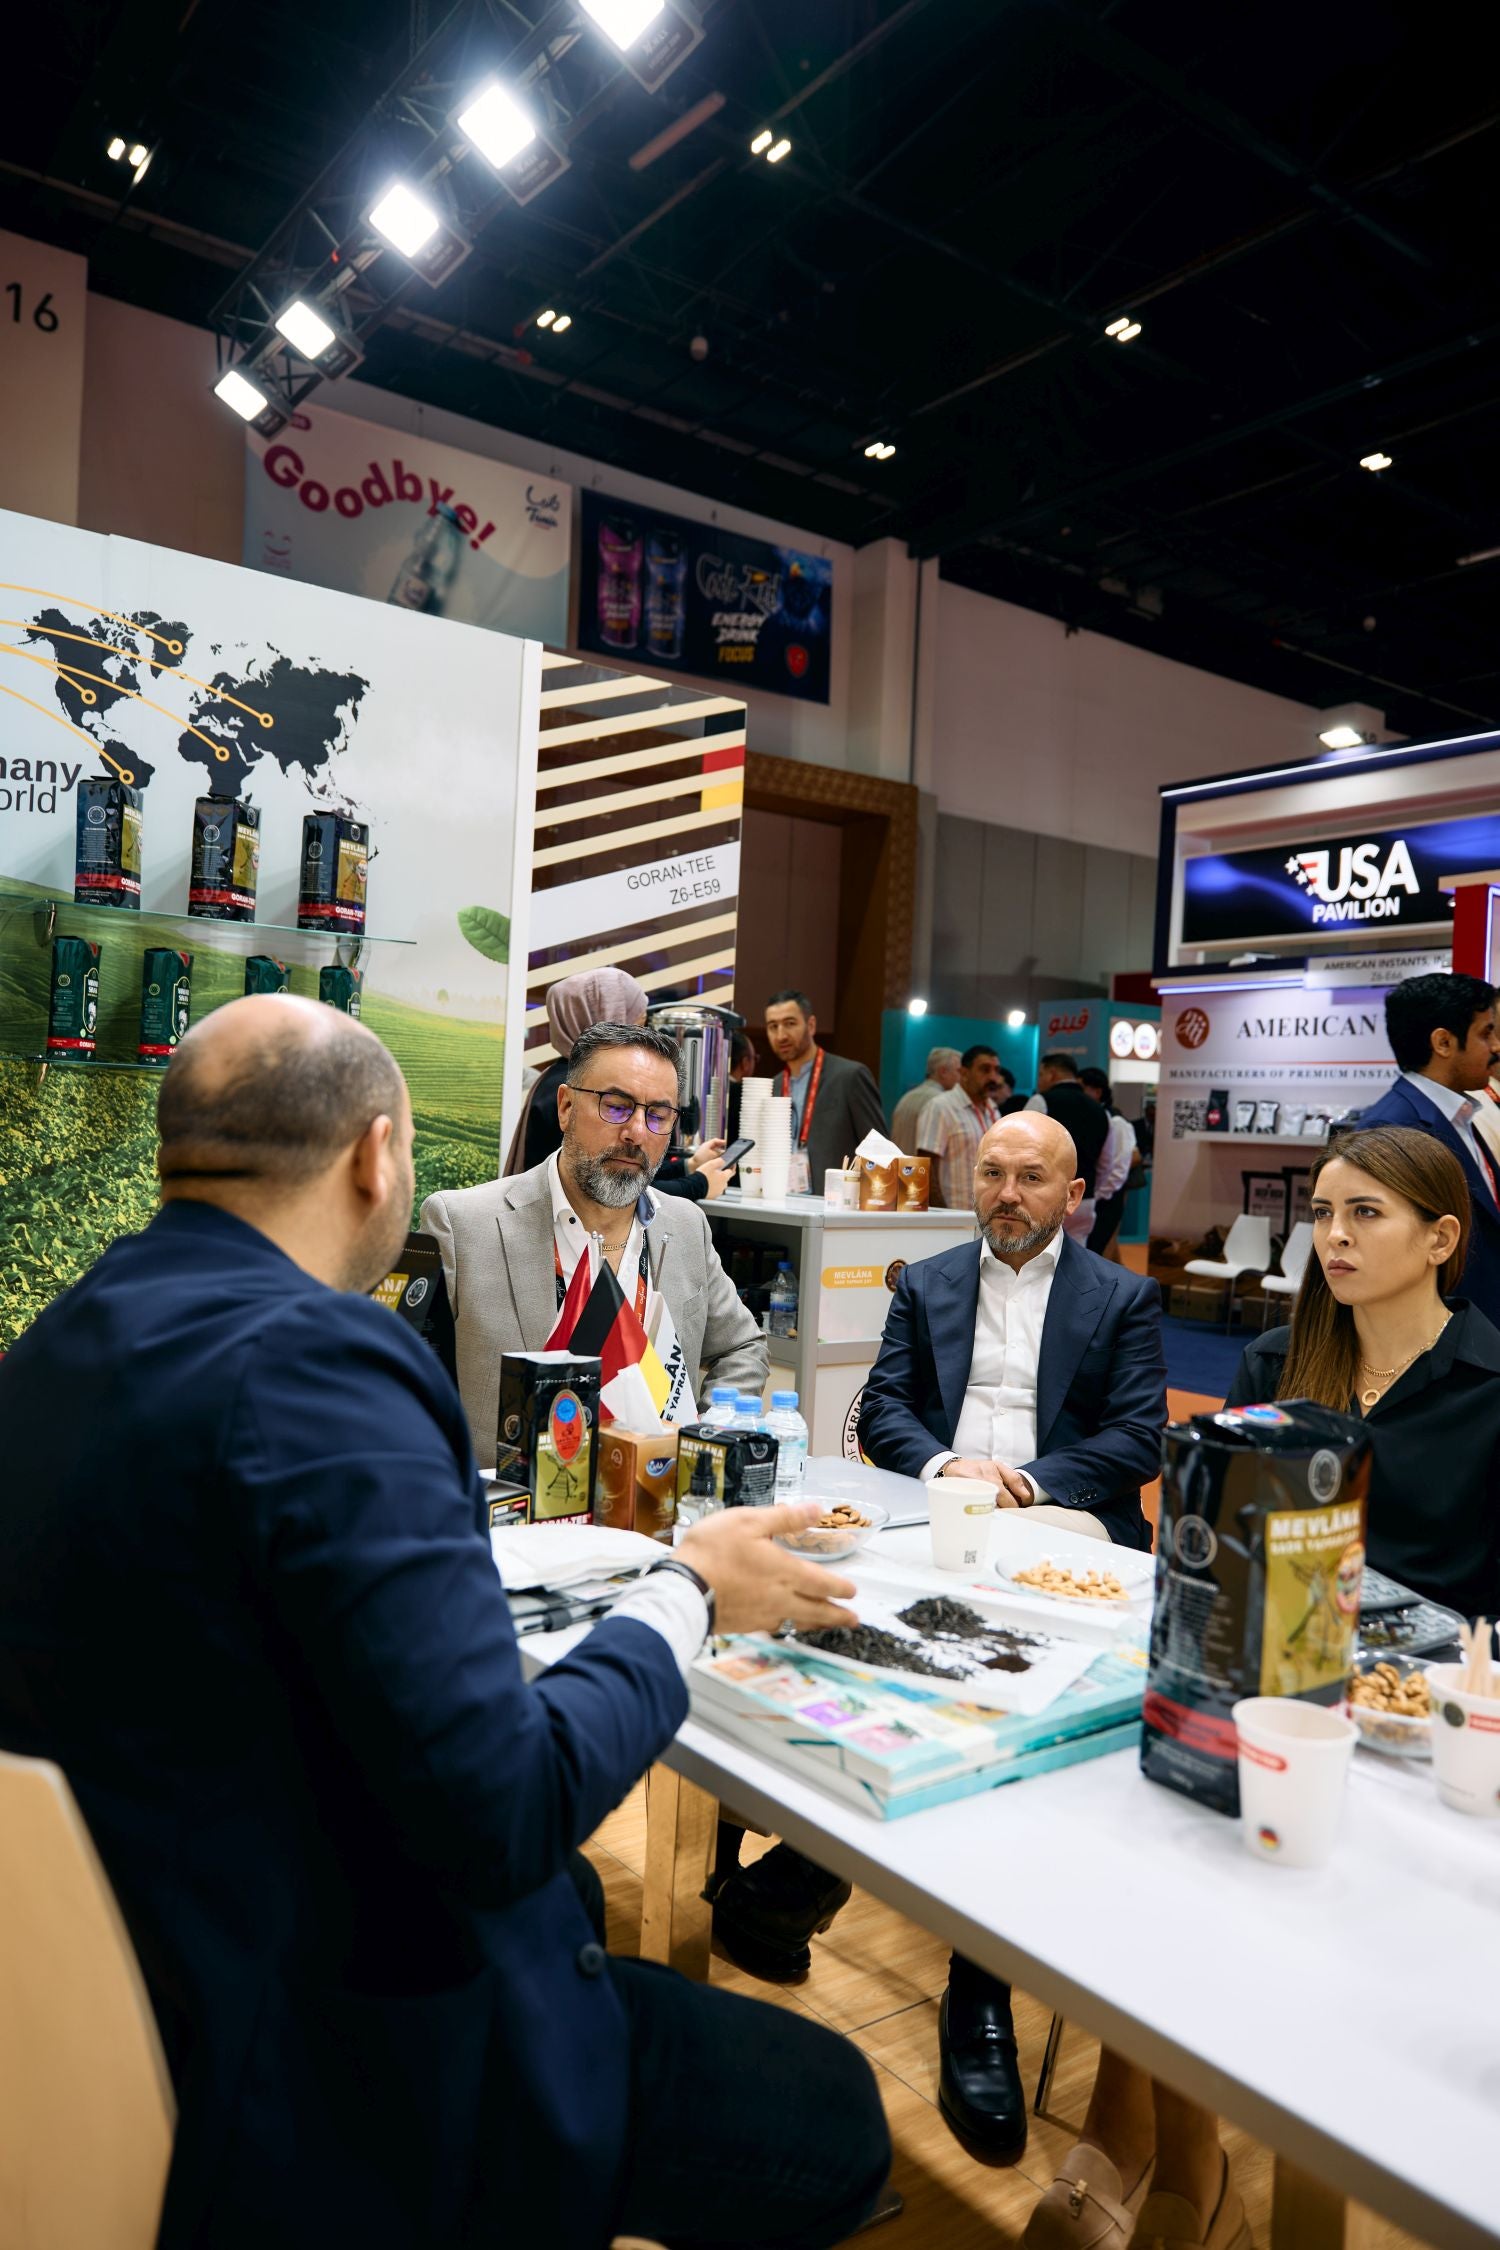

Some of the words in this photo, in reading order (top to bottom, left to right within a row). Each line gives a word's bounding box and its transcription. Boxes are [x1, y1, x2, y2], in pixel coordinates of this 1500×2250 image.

[5, 281, 59, 333] 16
[263, 444, 497, 552] Goodbye!
[627, 855, 716, 890] GORAN-TEE
[1296, 839, 1420, 902] USA
[669, 878, 721, 905] Z6-E59
[1312, 896, 1400, 924] PAVILION
[1324, 959, 1375, 970] AMERICAN
[1237, 1014, 1377, 1038] AMERICAN
[1169, 1068, 1265, 1079] MANUFACTURERS
[1270, 1069, 1286, 1078] OF
[1289, 1069, 1348, 1078] PREMIUM
